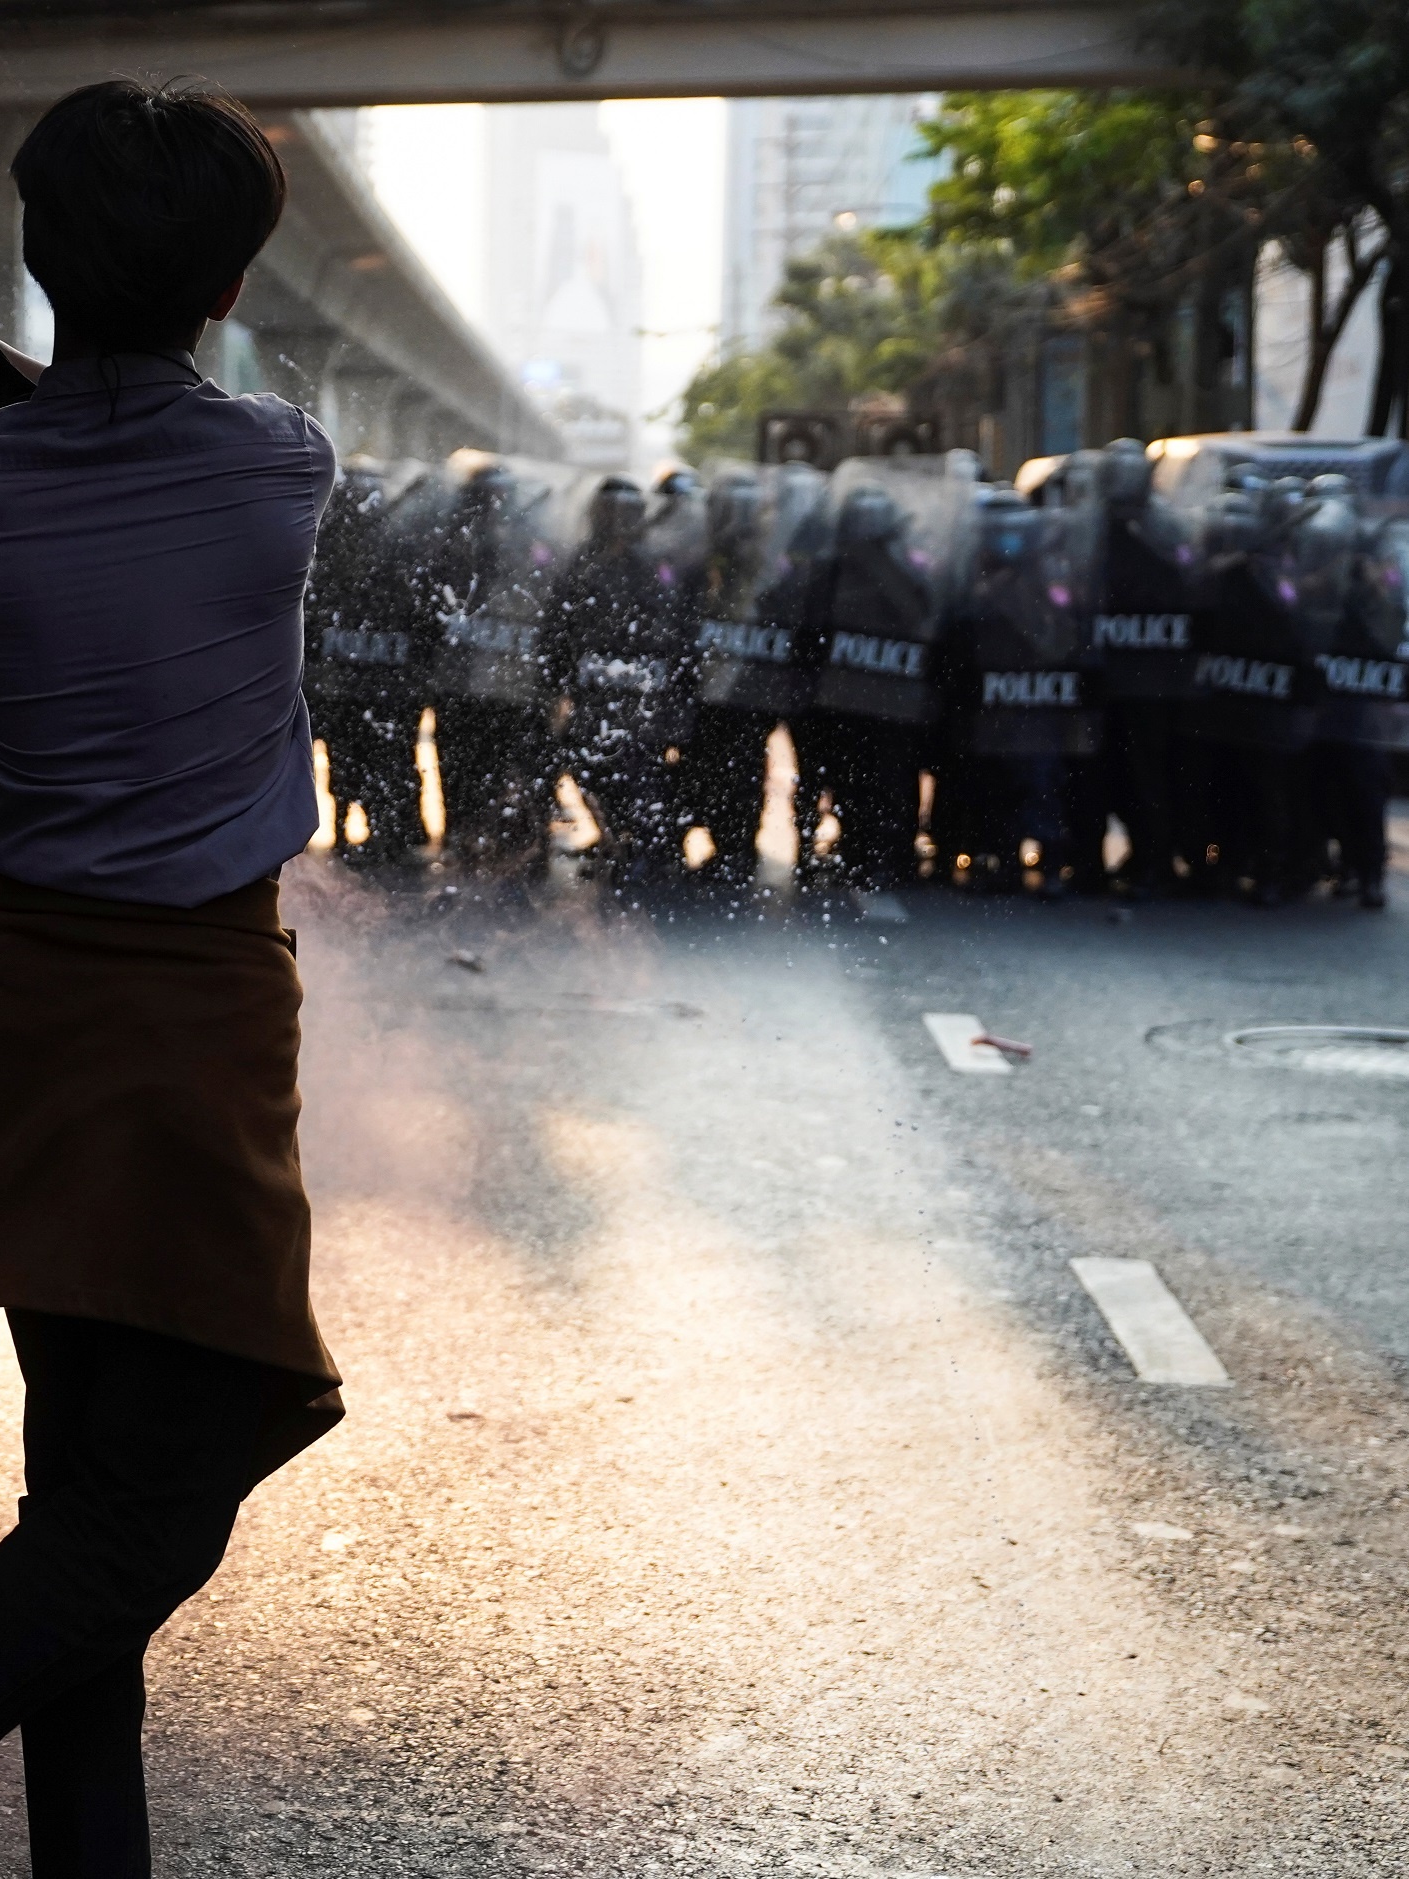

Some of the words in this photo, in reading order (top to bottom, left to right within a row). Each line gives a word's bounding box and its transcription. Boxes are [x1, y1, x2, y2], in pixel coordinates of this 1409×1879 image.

[699, 620, 792, 662] POLICE
[1093, 613, 1191, 649] POLICE
[830, 631, 927, 677] POLICE
[982, 671, 1081, 705] POLICE
[1194, 655, 1294, 698] POLICE
